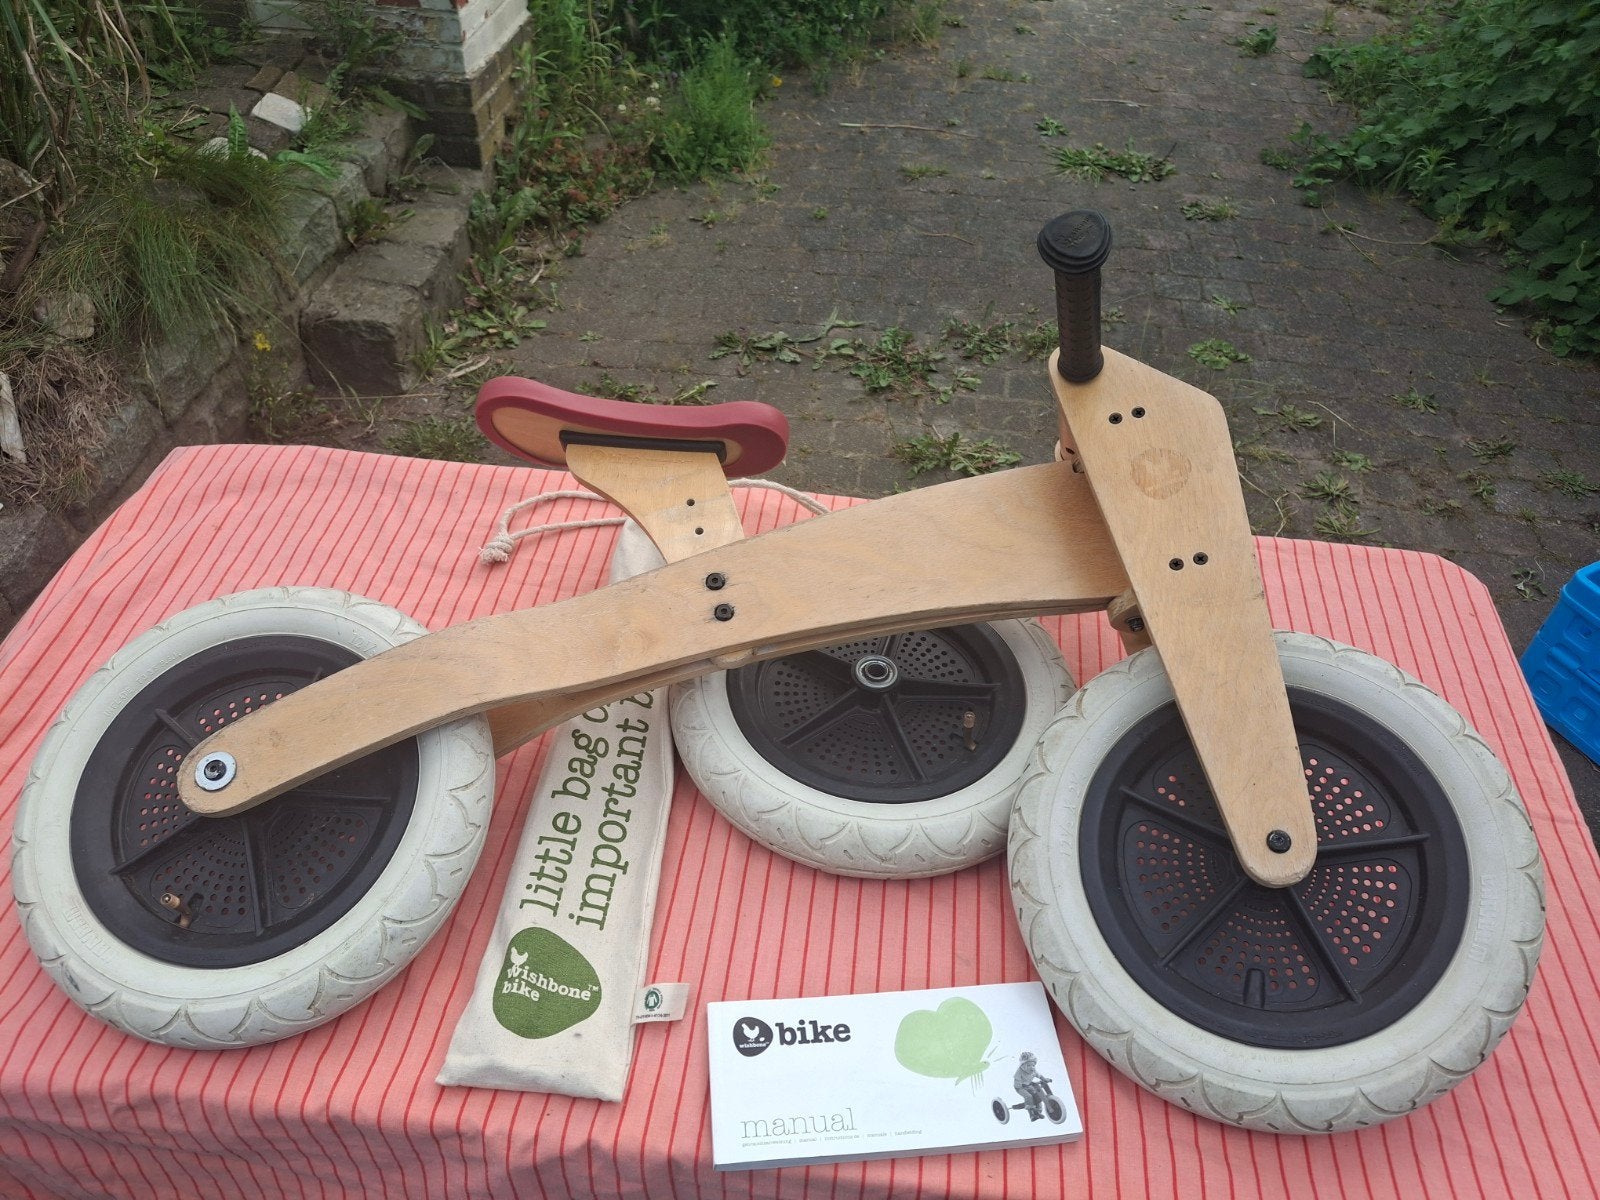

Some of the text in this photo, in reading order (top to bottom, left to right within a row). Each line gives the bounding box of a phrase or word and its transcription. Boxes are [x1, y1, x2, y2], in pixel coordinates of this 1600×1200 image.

[519, 811, 582, 918] little
[551, 728, 610, 801] bag
[568, 717, 650, 931] important
[501, 978, 541, 1002] bike
[774, 1018, 852, 1047] bike
[740, 1107, 858, 1139] manual
